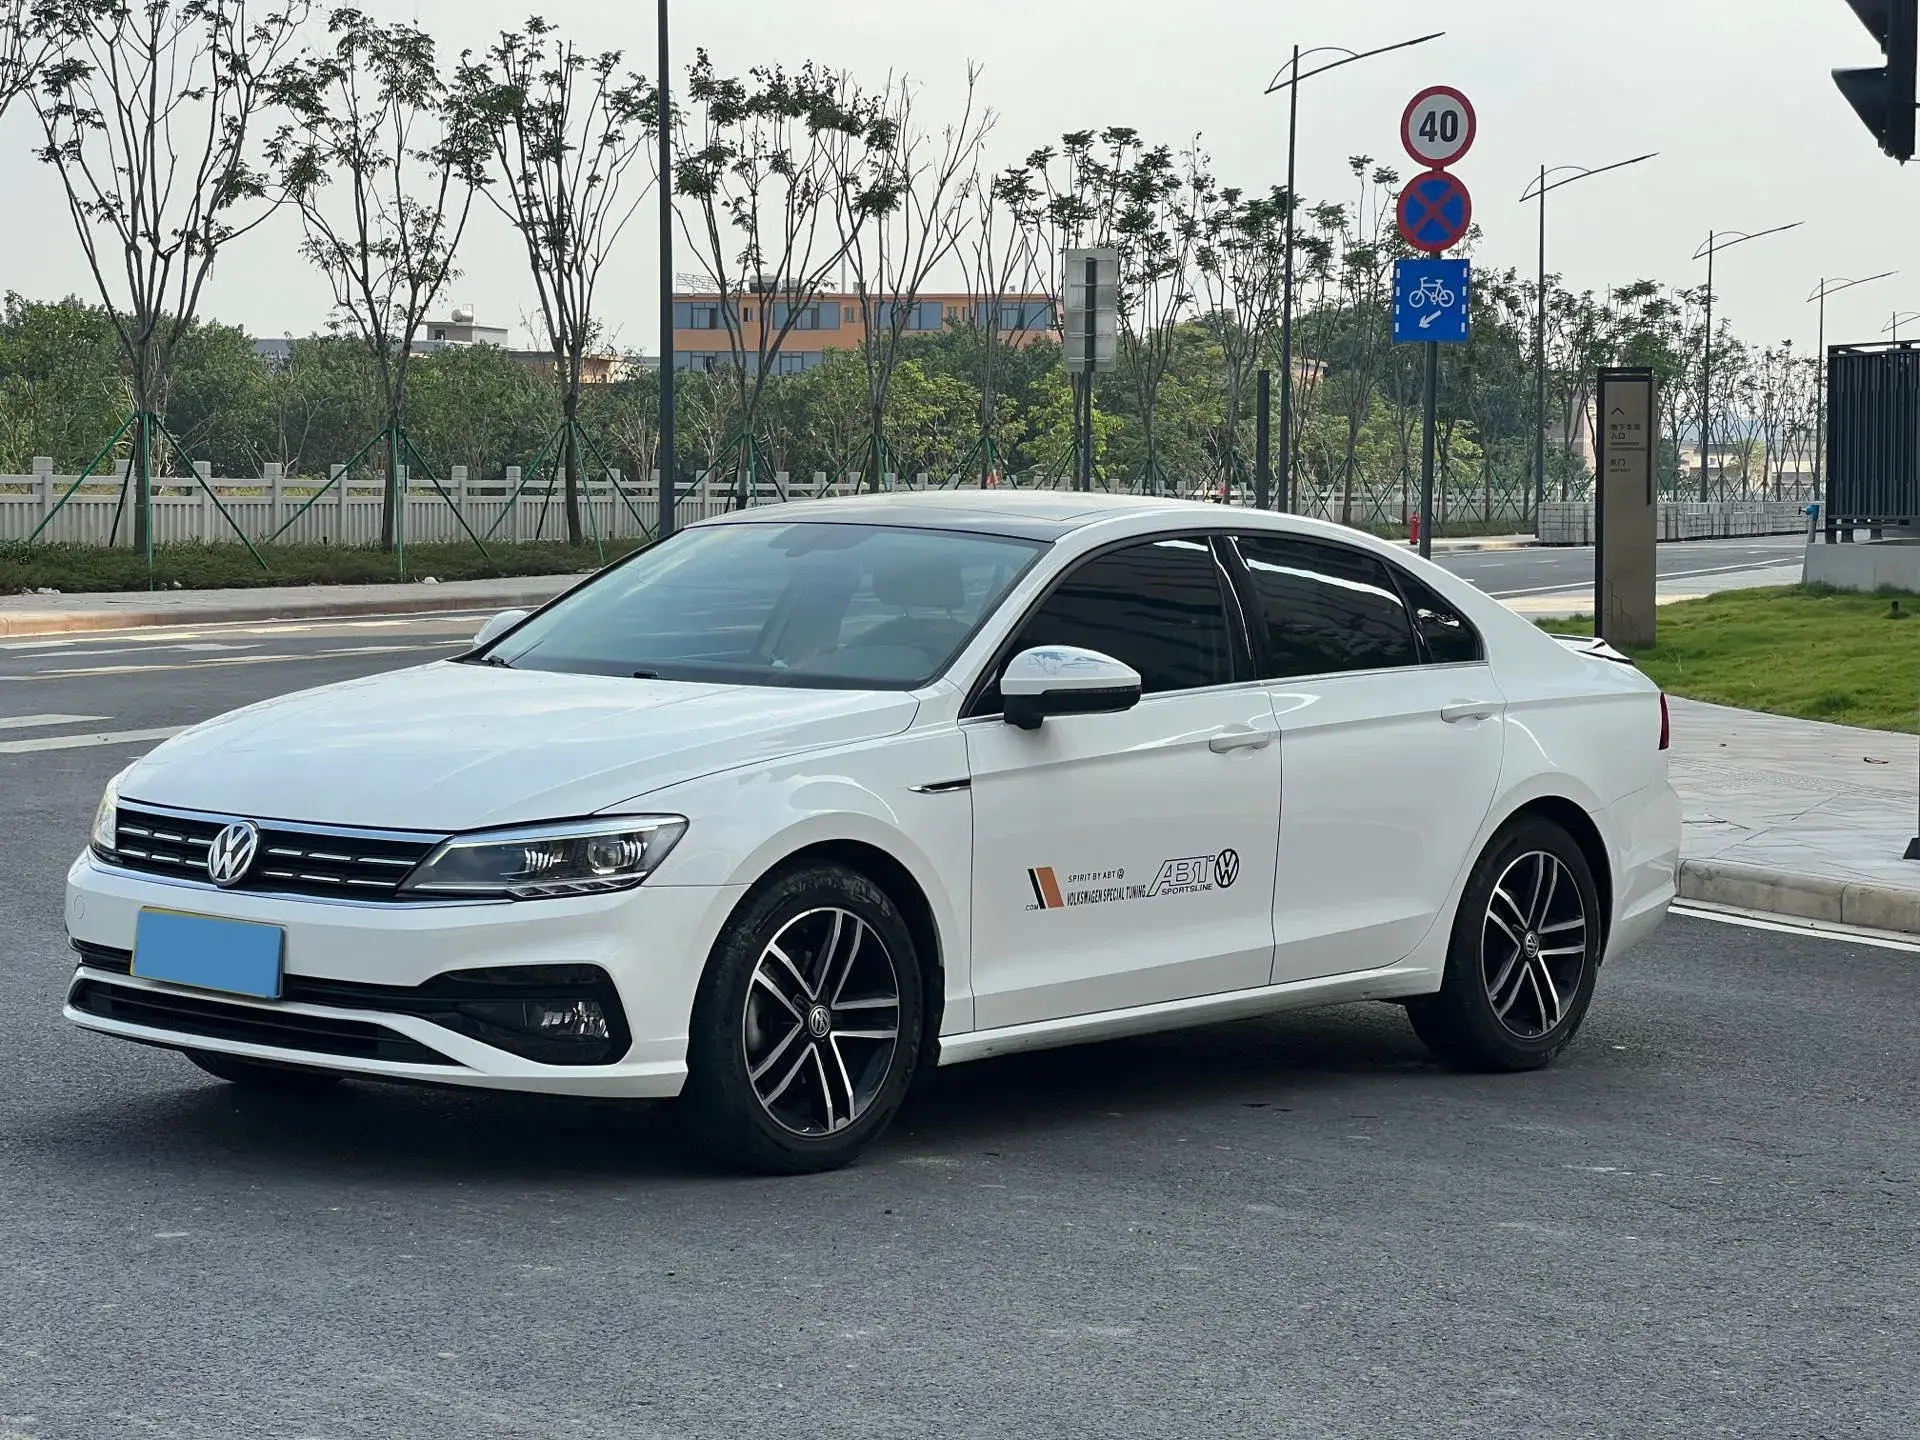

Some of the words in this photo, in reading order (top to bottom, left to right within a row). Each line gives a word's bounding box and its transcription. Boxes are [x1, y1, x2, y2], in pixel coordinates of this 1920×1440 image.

[1418, 109, 1459, 143] 40
[1610, 432, 1625, 440] 入口
[207, 821, 258, 886] VW
[1068, 873, 1091, 883] SPIRIT
[1092, 872, 1102, 880] BY
[1103, 870, 1116, 879] ABT
[1146, 855, 1216, 897] ABT
[1214, 848, 1240, 888] VW
[1067, 889, 1103, 906] VOLKSWAGEN
[1103, 886, 1125, 902] SPECIAL
[1161, 883, 1213, 895] SPORTSLINE
